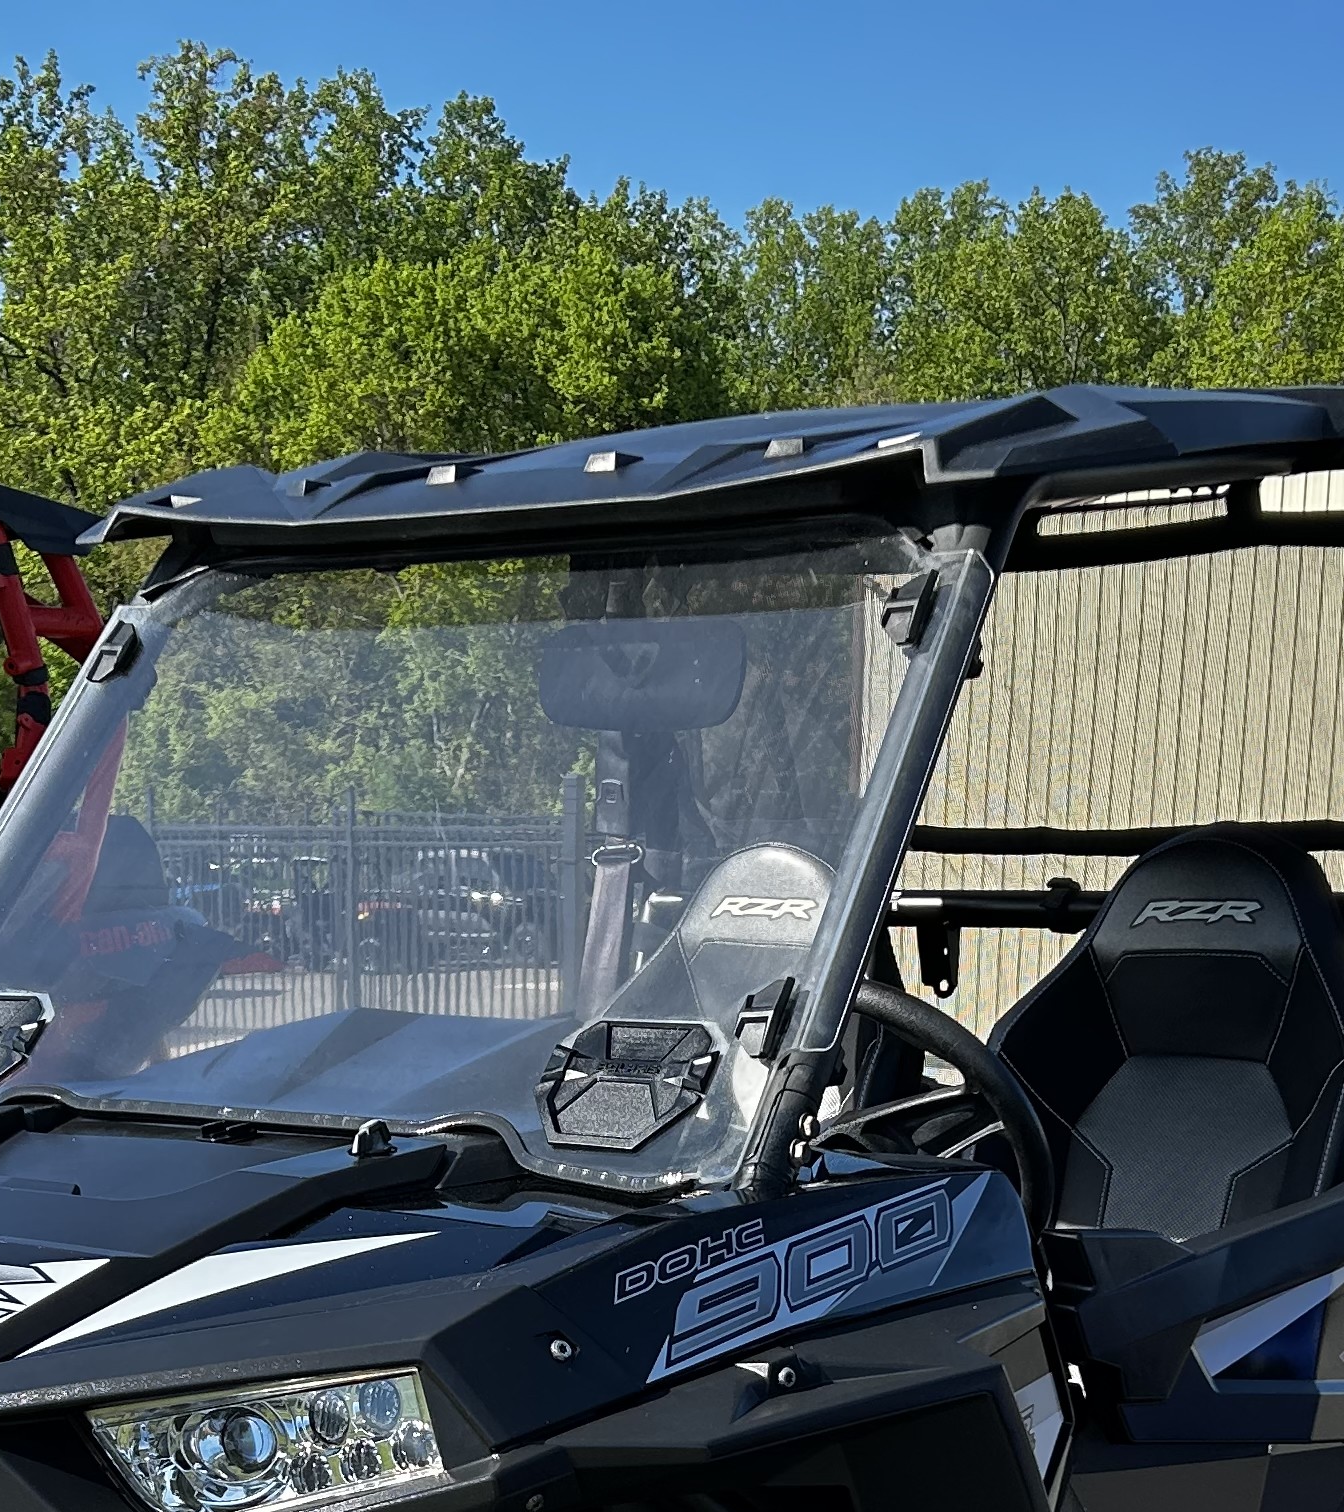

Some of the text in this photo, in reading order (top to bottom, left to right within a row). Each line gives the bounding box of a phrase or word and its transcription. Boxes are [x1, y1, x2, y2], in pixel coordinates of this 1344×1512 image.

[708, 895, 821, 921] RZR
[1132, 897, 1261, 927] RZR
[614, 1218, 766, 1304] DOHC
[665, 1184, 955, 1370] 900
